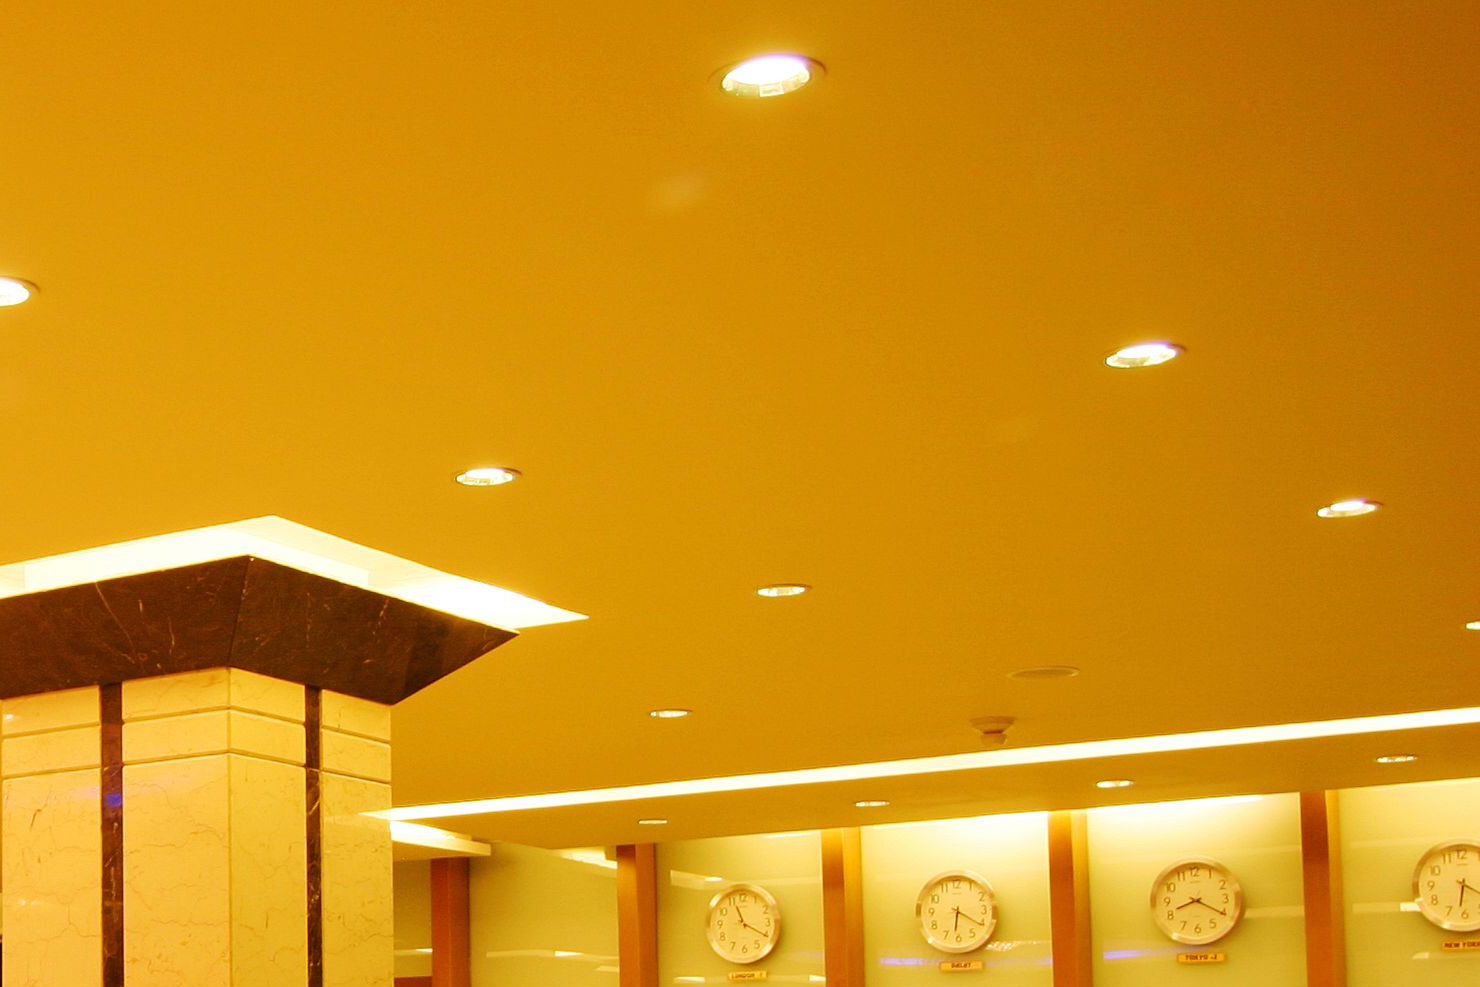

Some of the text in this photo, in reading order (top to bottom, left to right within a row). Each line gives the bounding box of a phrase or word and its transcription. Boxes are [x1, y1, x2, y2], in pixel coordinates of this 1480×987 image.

[1442, 853, 1452, 864] 11
[1456, 849, 1467, 860] 12
[1189, 866, 1200, 878] 12
[1430, 865, 1441, 876] 10
[1177, 871, 1186, 881] 11
[941, 882, 949, 893] 11
[952, 879, 961, 889] 12
[1166, 882, 1176, 893] 10
[1219, 879, 1226, 890] 2
[1427, 880, 1435, 891] 9
[728, 897, 736, 906] 11
[738, 893, 747, 903] 12
[930, 894, 939, 904] 10
[979, 892, 985, 902] 2
[1164, 897, 1171, 907] 9
[1223, 894, 1230, 904] 3
[1431, 895, 1438, 906] 8
[719, 908, 728, 917] 10
[763, 905, 769, 915] 2
[928, 907, 935, 917] 9
[981, 905, 987, 915] 3
[1446, 906, 1453, 917] 7
[1461, 910, 1469, 920] 6
[1167, 911, 1175, 921] 8
[717, 919, 724, 929] 9
[765, 918, 771, 927] 3
[931, 920, 938, 930] 8
[1180, 920, 1187, 931] 7
[1209, 919, 1217, 929] 5
[1194, 923, 1202, 934] 6
[720, 931, 726, 941] 8
[943, 930, 950, 941] 7
[956, 933, 962, 943] 6
[969, 929, 976, 939] 5
[730, 942, 736, 951] 7
[742, 944, 748, 954] 6
[754, 940, 761, 949] 5
